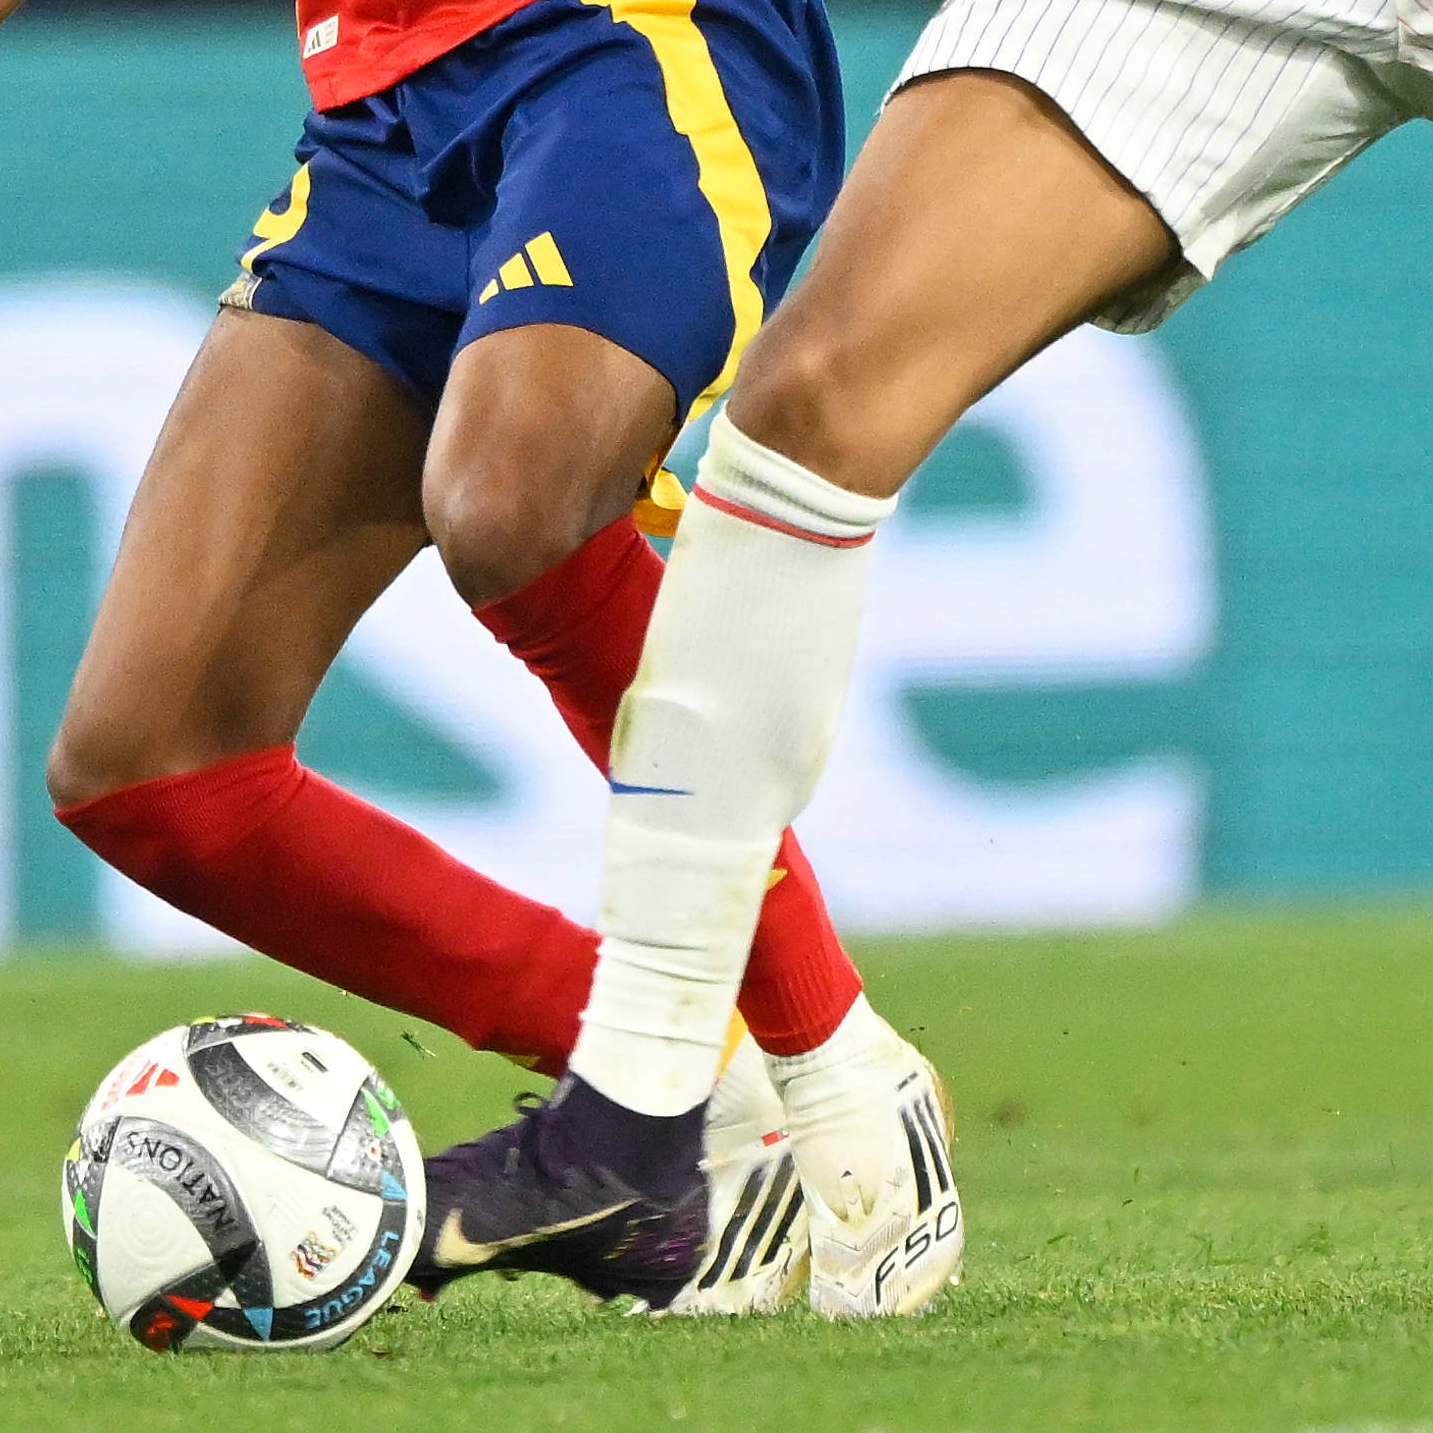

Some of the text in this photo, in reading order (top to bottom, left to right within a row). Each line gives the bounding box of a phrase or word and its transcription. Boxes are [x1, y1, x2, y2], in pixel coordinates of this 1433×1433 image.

[127, 1131, 237, 1233] NATIONS
[304, 1229, 400, 1329] LEAGUE
[875, 1202, 958, 1307] F50
